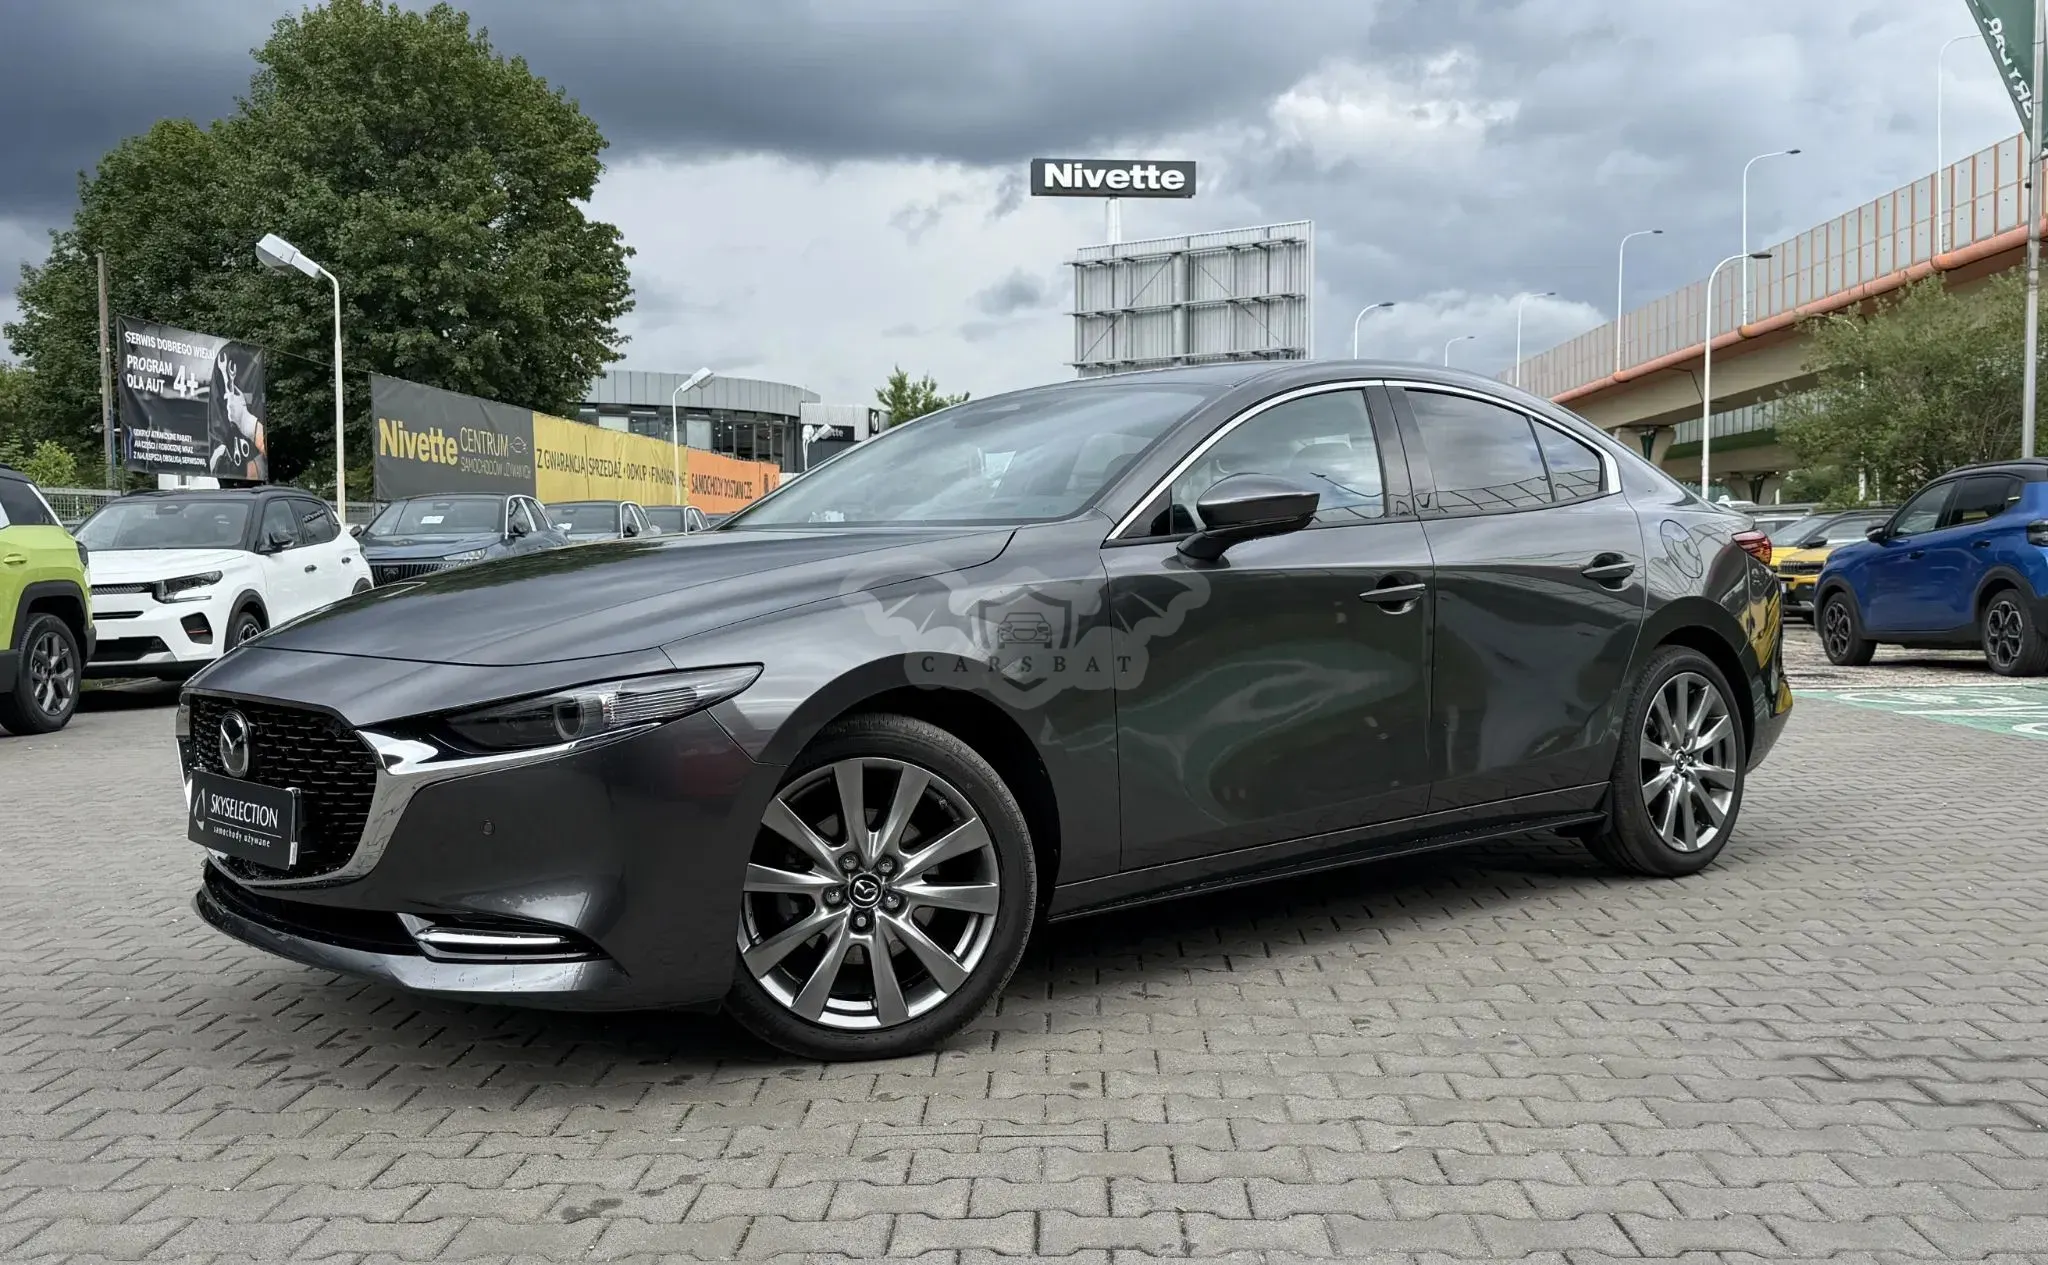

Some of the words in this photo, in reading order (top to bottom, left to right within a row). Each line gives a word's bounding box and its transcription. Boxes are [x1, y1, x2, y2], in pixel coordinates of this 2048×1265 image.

[1044, 162, 1186, 191] Nivette
[125, 331, 156, 349] SERWIS
[157, 338, 193, 356] DOBREGO
[127, 354, 173, 376] PROGRAM
[127, 373, 145, 390] DLA
[146, 377, 166, 394] AUT
[174, 365, 199, 397] 4+
[379, 418, 458, 466] Nivette
[460, 426, 509, 458] CENTRUM
[536, 449, 543, 469] Z
[588, 458, 622, 478] SPRZEDAŻ
[210, 793, 279, 829] SKYSELECTION
[213, 826, 242, 842] samochody
[244, 833, 271, 848] używane
